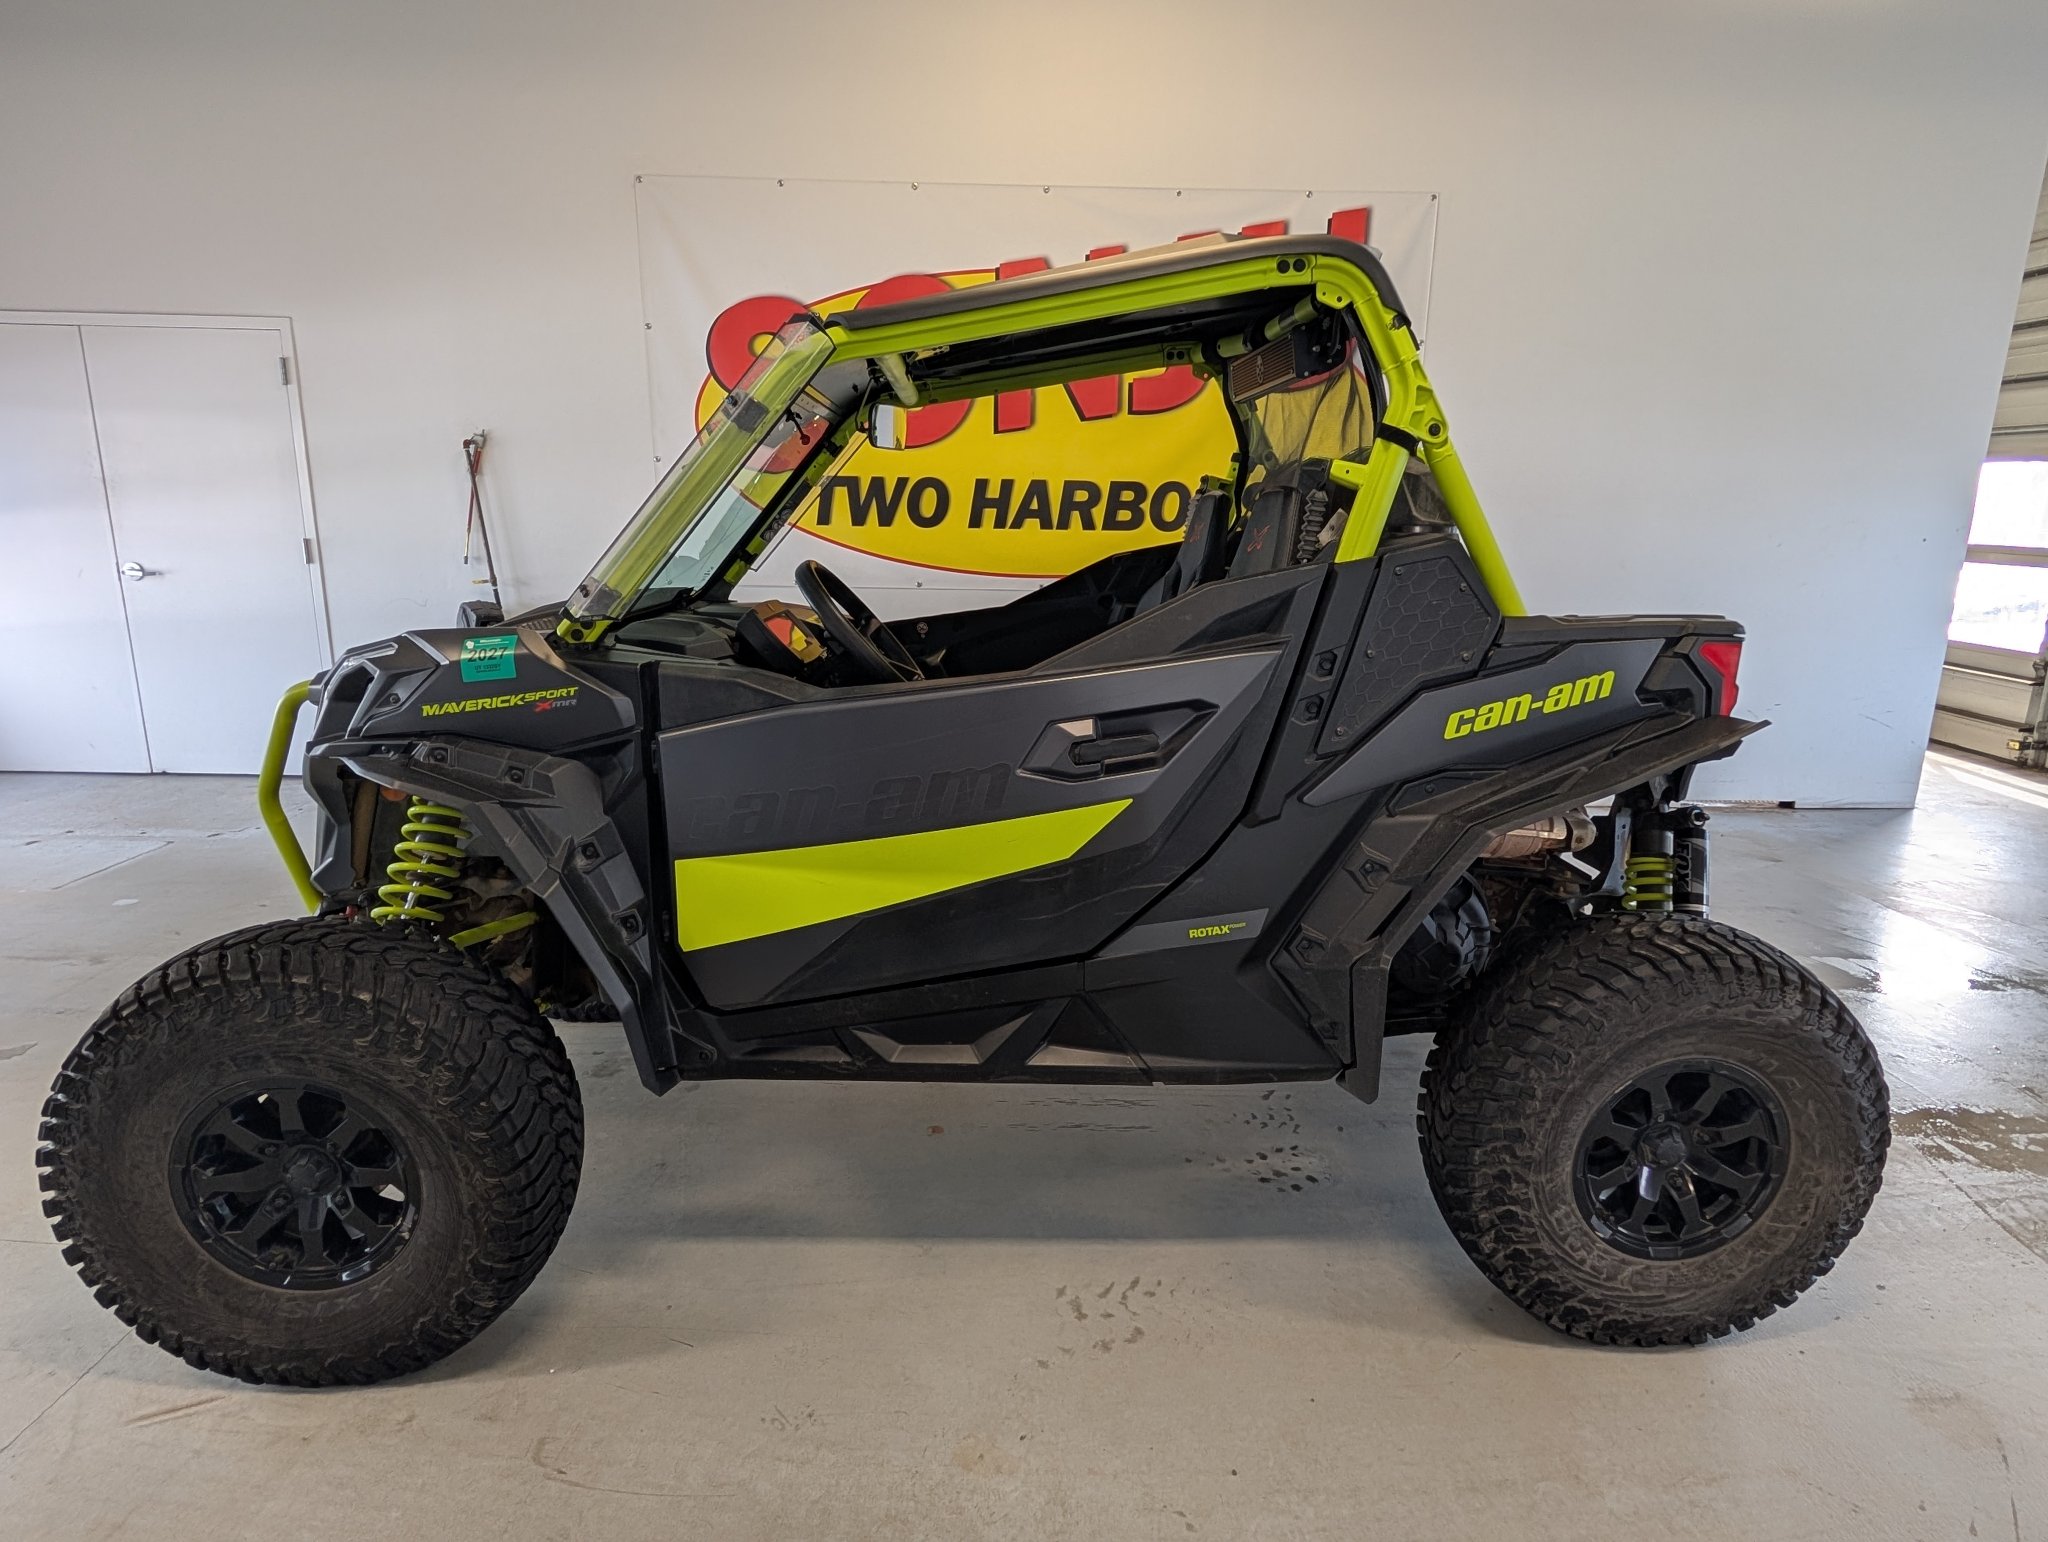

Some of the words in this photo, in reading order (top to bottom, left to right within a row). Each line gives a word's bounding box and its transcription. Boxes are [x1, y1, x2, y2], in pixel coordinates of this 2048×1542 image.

[815, 475, 951, 529] TWO
[967, 478, 1193, 532] HARBO
[467, 646, 508, 662] 2027
[1443, 669, 1616, 741] can-am
[1188, 924, 1230, 939] ROTAX
